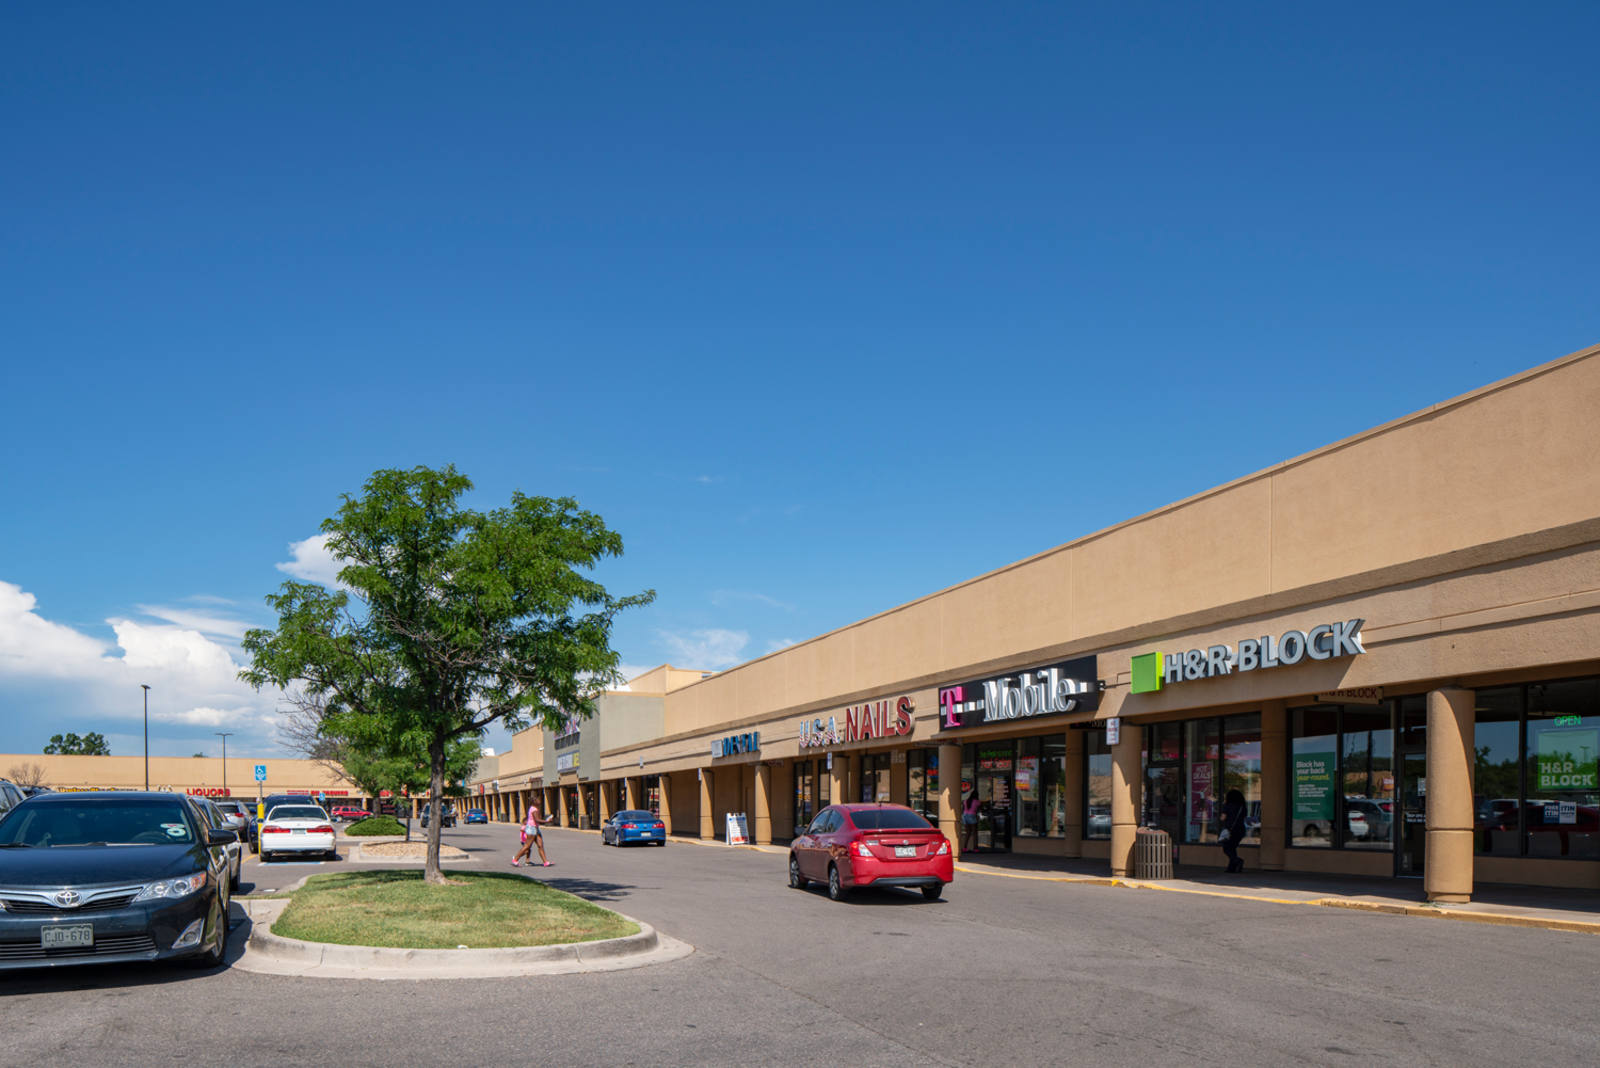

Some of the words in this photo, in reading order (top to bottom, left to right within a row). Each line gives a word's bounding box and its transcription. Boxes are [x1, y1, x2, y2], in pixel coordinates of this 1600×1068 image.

[1165, 644, 1233, 684] H&R
[1238, 619, 1368, 672] BLOCK
[846, 696, 915, 742] NAILS
[1553, 715, 1582, 727] OPEN
[723, 731, 761, 757] DENTAL
[1541, 762, 1574, 774] H&R
[1541, 774, 1593, 786] BLOCK
[186, 788, 231, 797] LIQUORS
